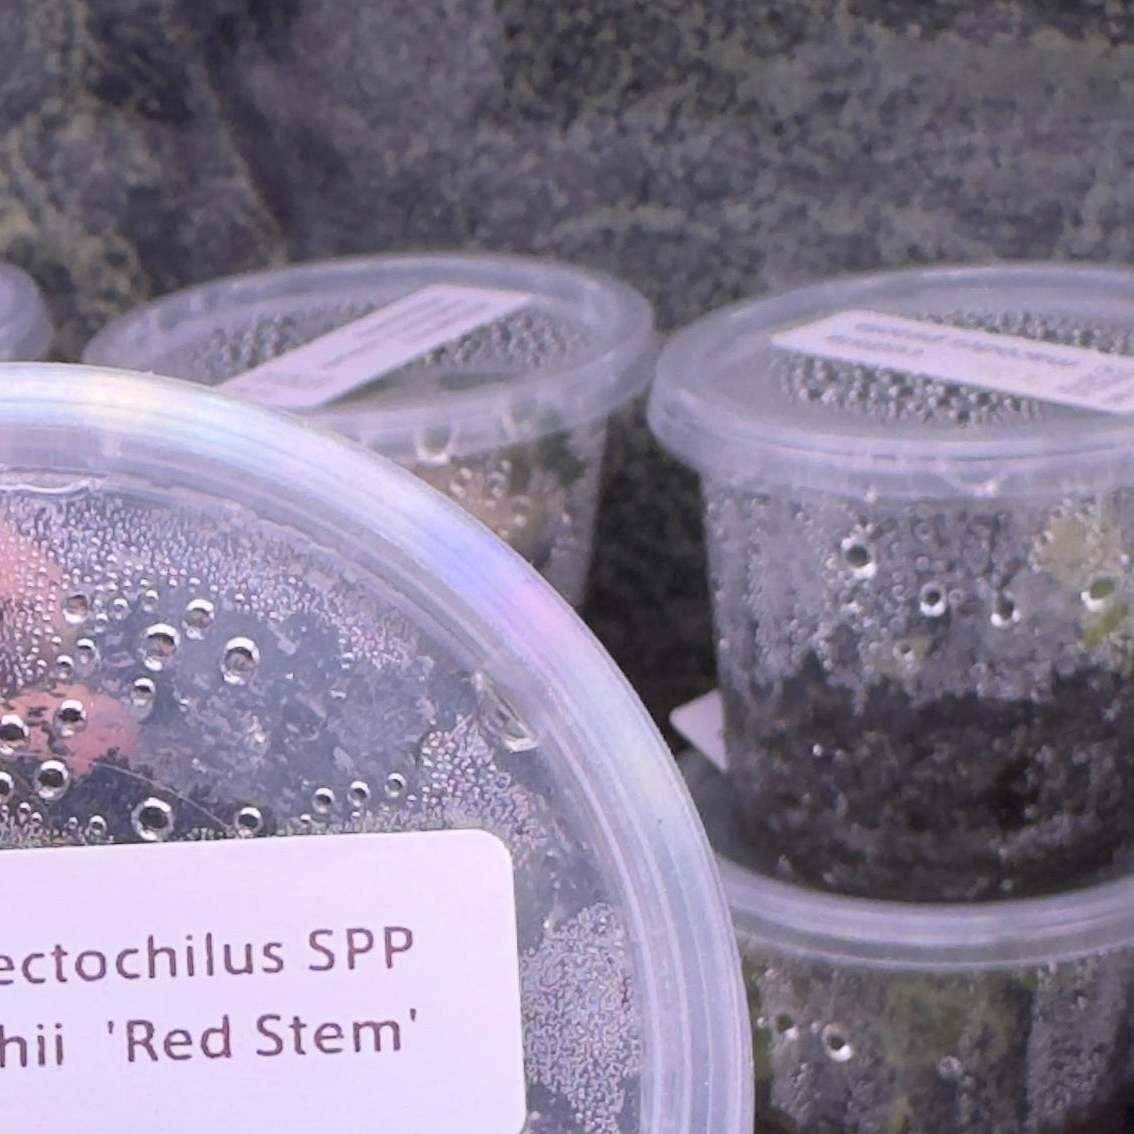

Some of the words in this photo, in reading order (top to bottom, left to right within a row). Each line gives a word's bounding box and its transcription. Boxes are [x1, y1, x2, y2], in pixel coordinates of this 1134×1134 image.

[307, 925, 414, 972] SPP
[106, 1013, 234, 1063] 'Red
[255, 1007, 418, 1057] Stem'
